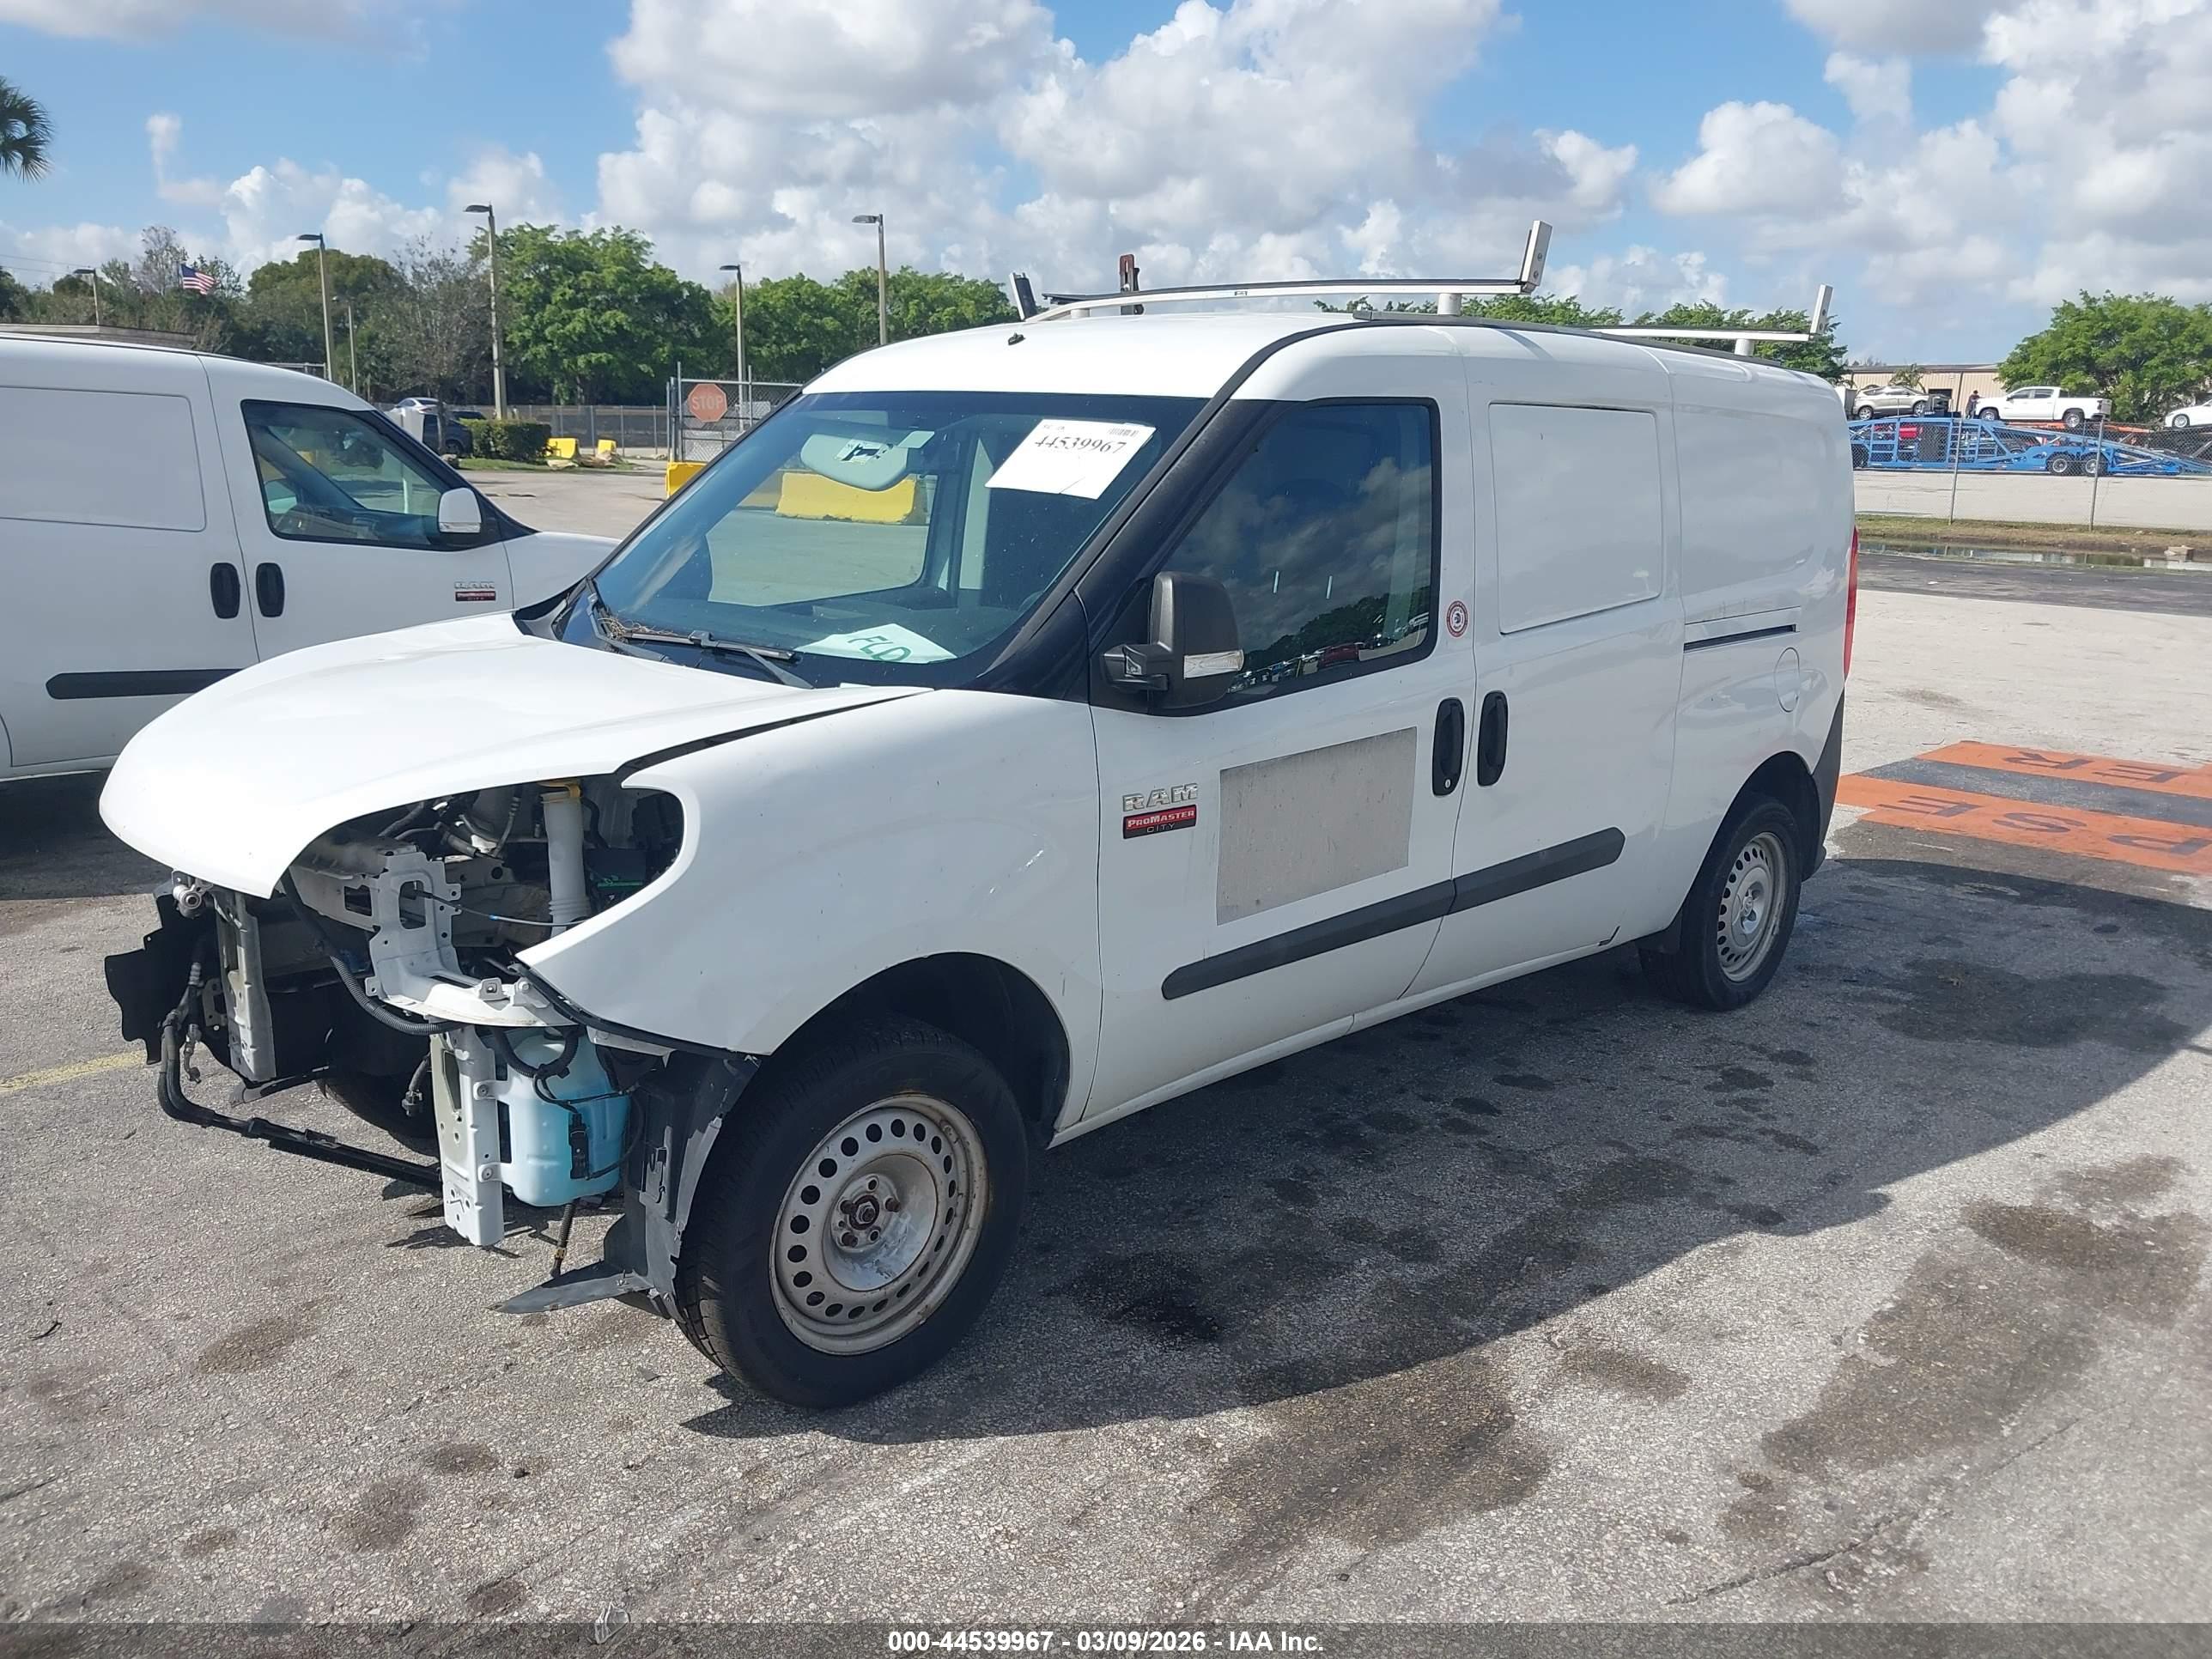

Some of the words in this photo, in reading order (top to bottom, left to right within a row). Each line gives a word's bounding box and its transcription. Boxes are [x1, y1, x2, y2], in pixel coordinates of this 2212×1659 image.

[691, 394, 723, 410] STOP
[1034, 434, 1127, 454] 44539967
[1122, 782, 1199, 811] RAM
[1146, 823, 1176, 833] CITY
